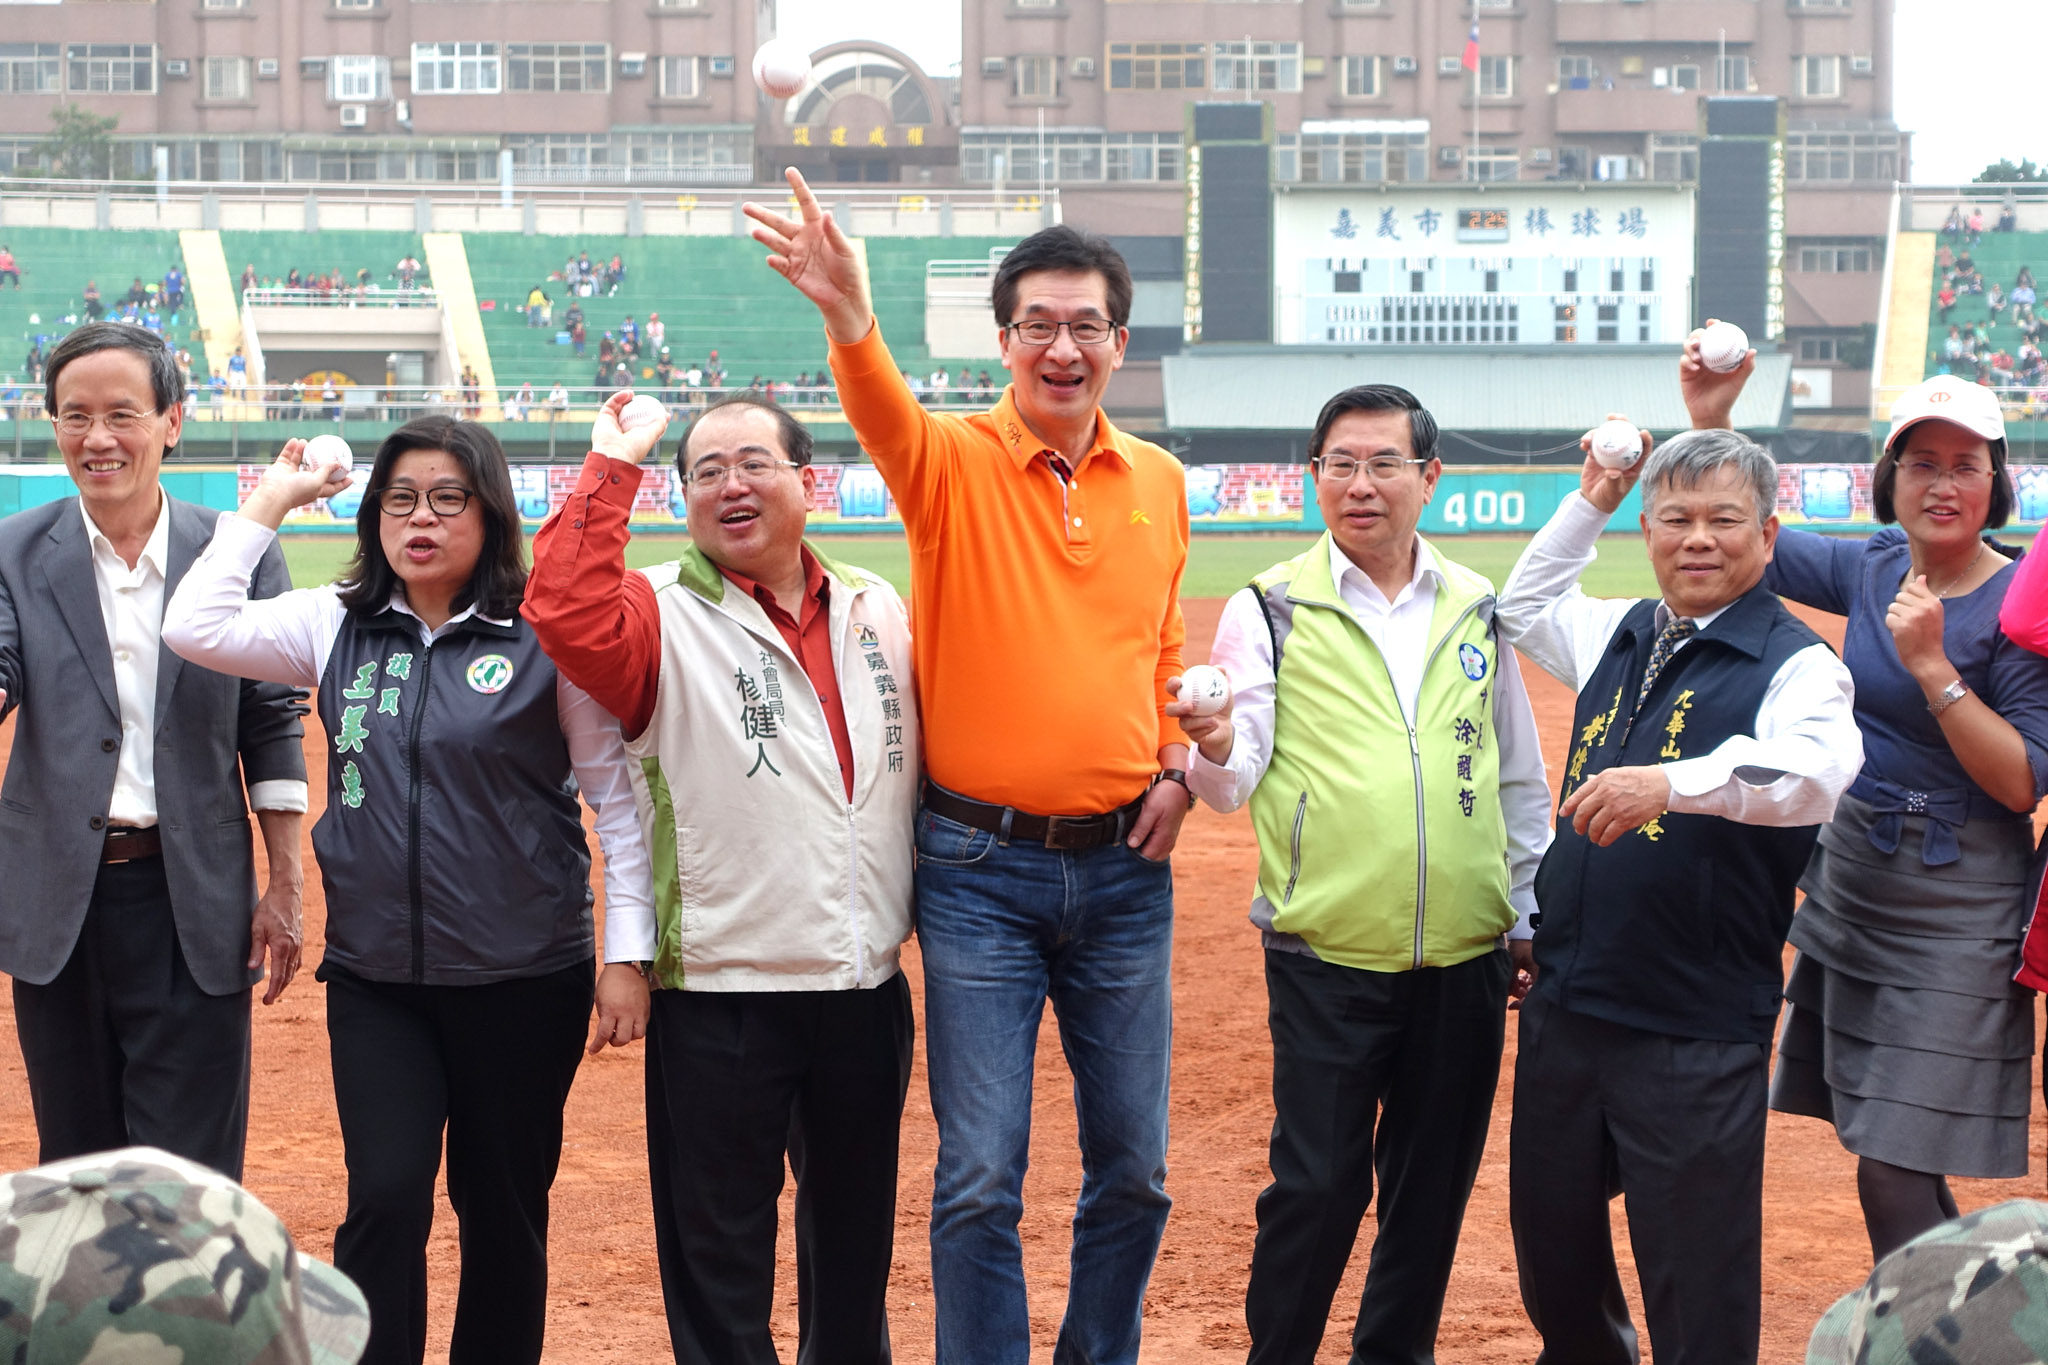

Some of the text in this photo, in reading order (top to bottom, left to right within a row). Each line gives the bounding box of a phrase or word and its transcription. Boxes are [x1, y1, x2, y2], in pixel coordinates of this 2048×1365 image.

[1187, 163, 1200, 180] 2
[1769, 196, 1784, 212] 4
[1329, 206, 1649, 241] 嘉義市 棒球場
[1769, 213, 1784, 230] 5
[1769, 231, 1783, 248] 6
[1187, 253, 1200, 270] 7
[1769, 249, 1783, 266] 7
[1768, 267, 1783, 285] 8
[1768, 286, 1783, 303] 9
[1443, 489, 1525, 528] 400
[377, 653, 413, 716] 議員
[864, 652, 903, 773] 嘉義縣政府
[334, 660, 378, 808] 王美惠
[1454, 717, 1477, 817] 涂醒哲
